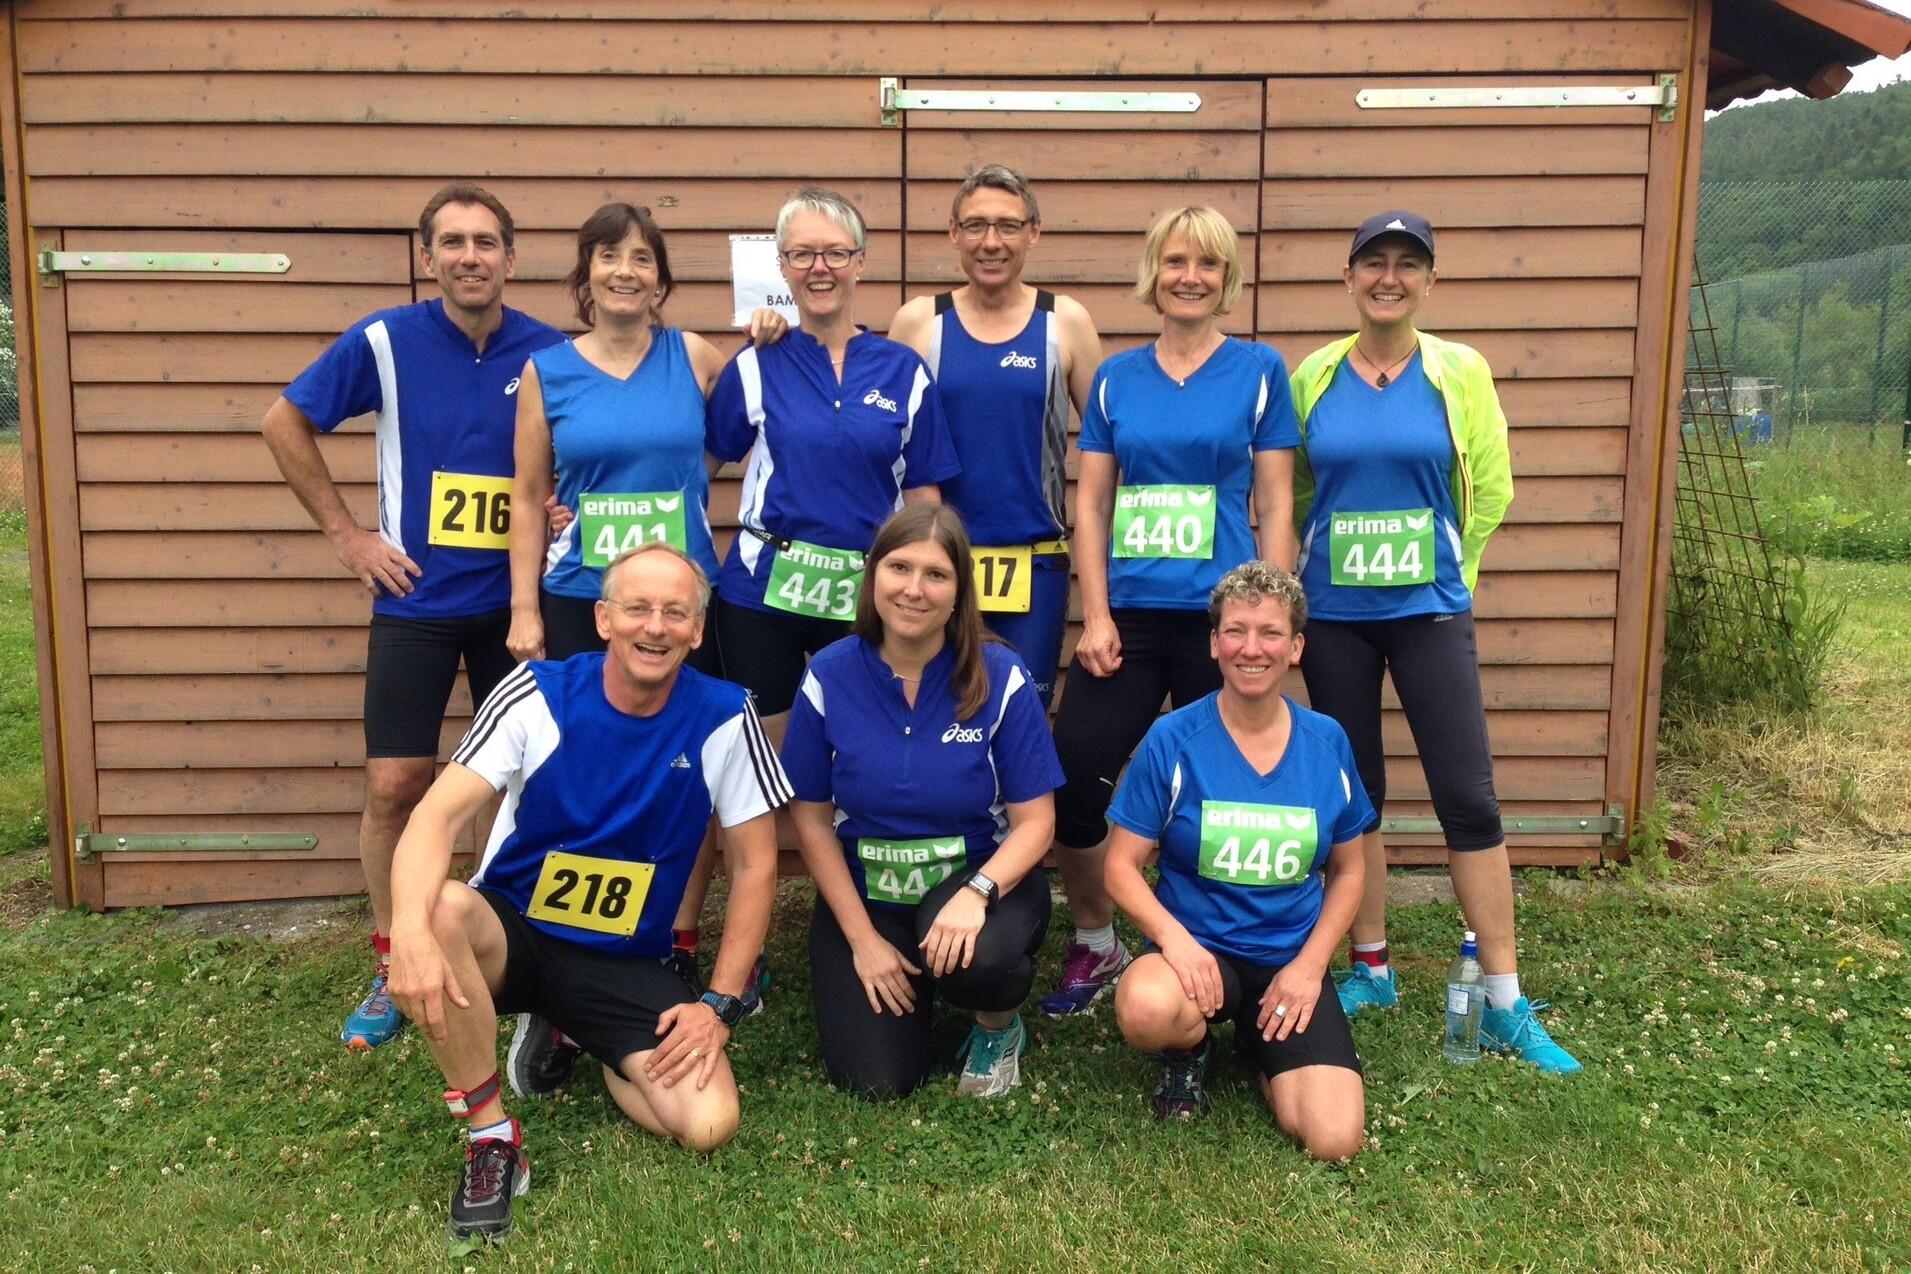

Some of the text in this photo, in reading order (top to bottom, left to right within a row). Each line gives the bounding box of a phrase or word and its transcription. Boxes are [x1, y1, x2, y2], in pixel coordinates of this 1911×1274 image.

[441, 488, 511, 536] 216
[584, 496, 653, 516] erima
[1121, 489, 1184, 509] erima
[1123, 515, 1203, 554] 440
[1334, 516, 1403, 535] erima
[971, 555, 1018, 598] 17
[1342, 540, 1424, 581] 444
[778, 571, 856, 616] 443
[1206, 808, 1282, 831] erima
[862, 843, 930, 864] erima
[1212, 836, 1302, 881] 446
[543, 868, 633, 919] 218
